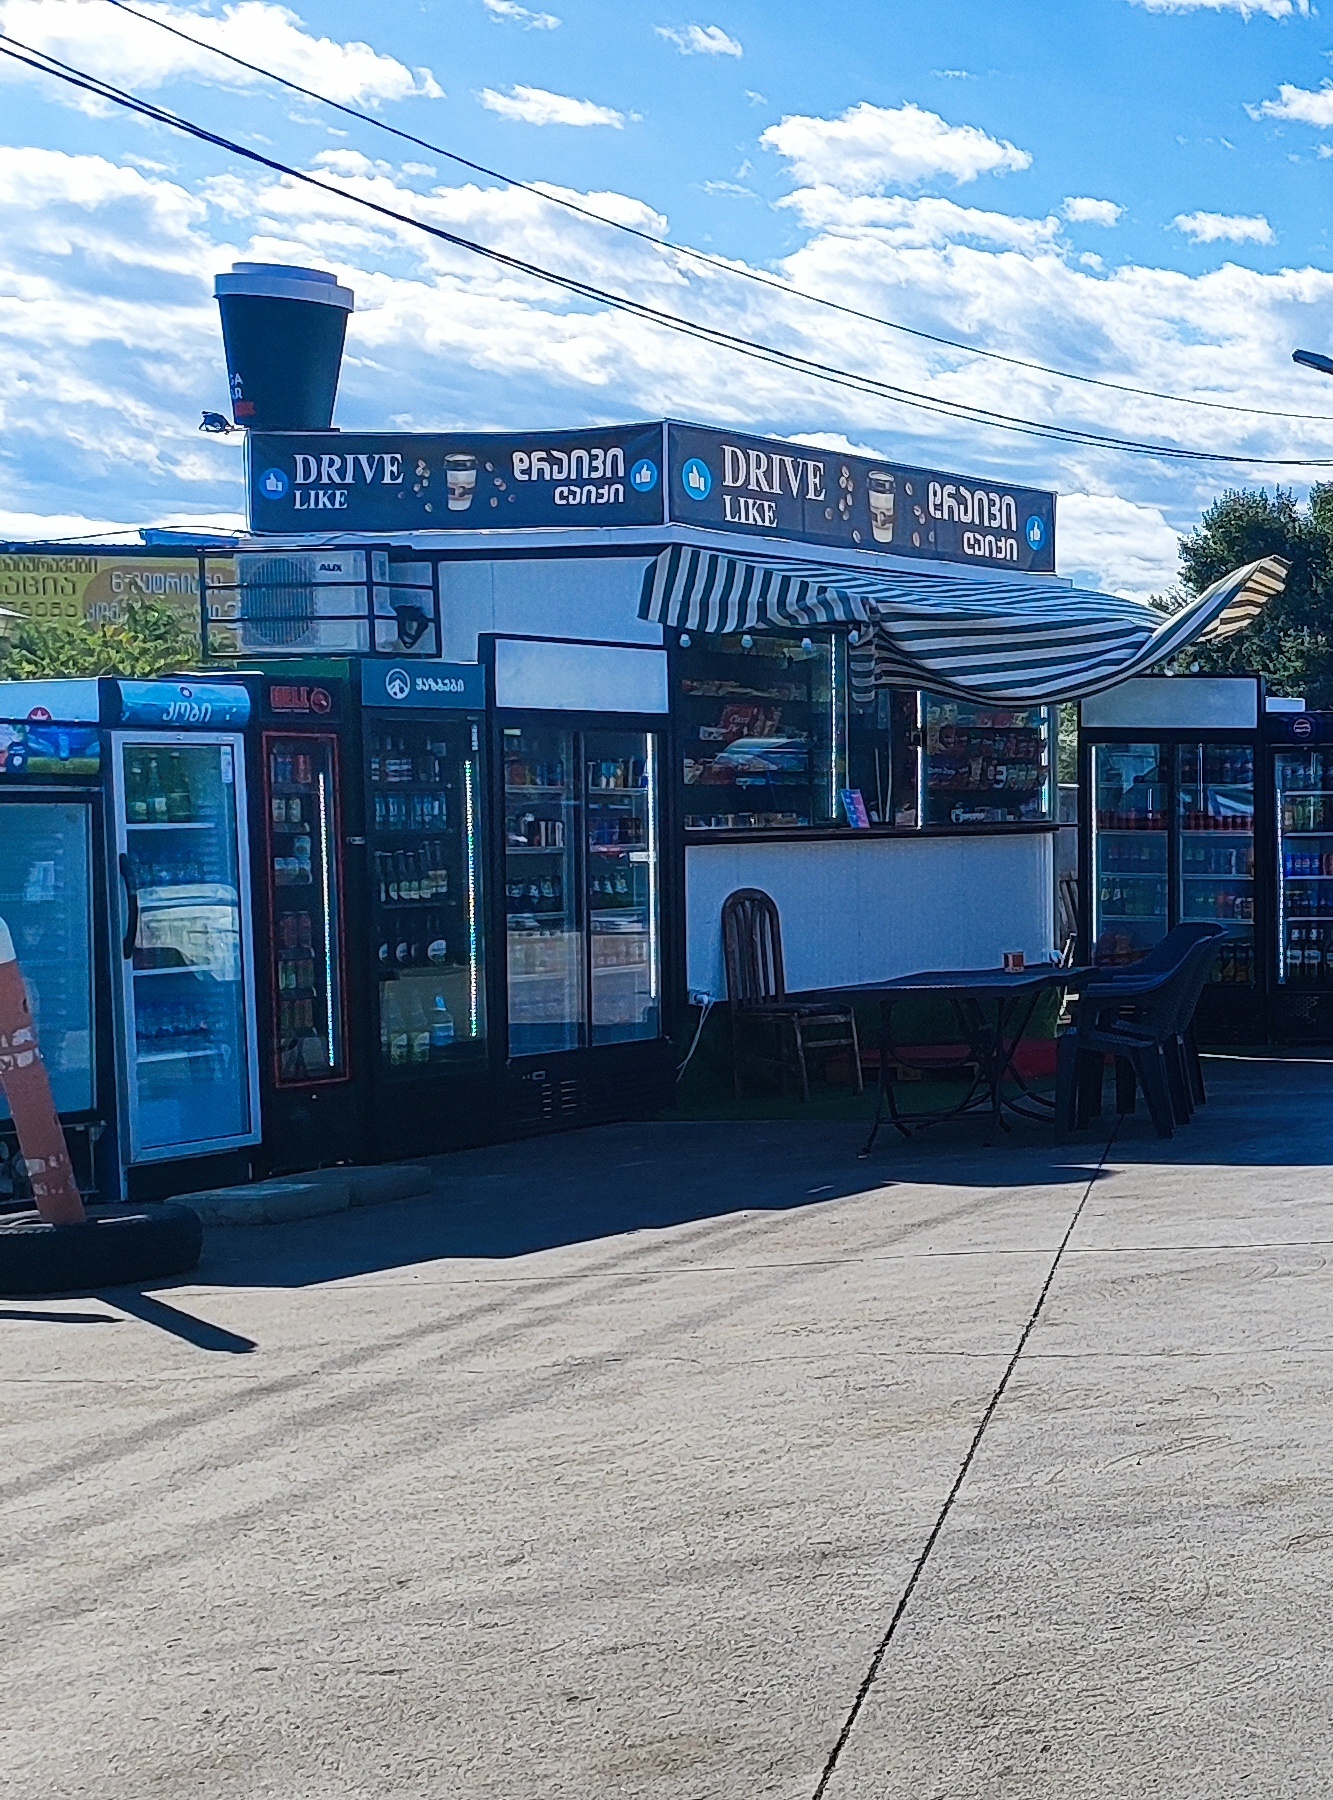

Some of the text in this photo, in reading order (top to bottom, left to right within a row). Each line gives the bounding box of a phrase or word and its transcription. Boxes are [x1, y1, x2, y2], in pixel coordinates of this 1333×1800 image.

[293, 452, 405, 485] DRIVE
[719, 444, 827, 501] DRIVE
[293, 489, 348, 510] LIKE
[722, 494, 779, 528] LIKE
[415, 677, 465, 693] ყაზბეგი
[162, 701, 212, 722] კობი
